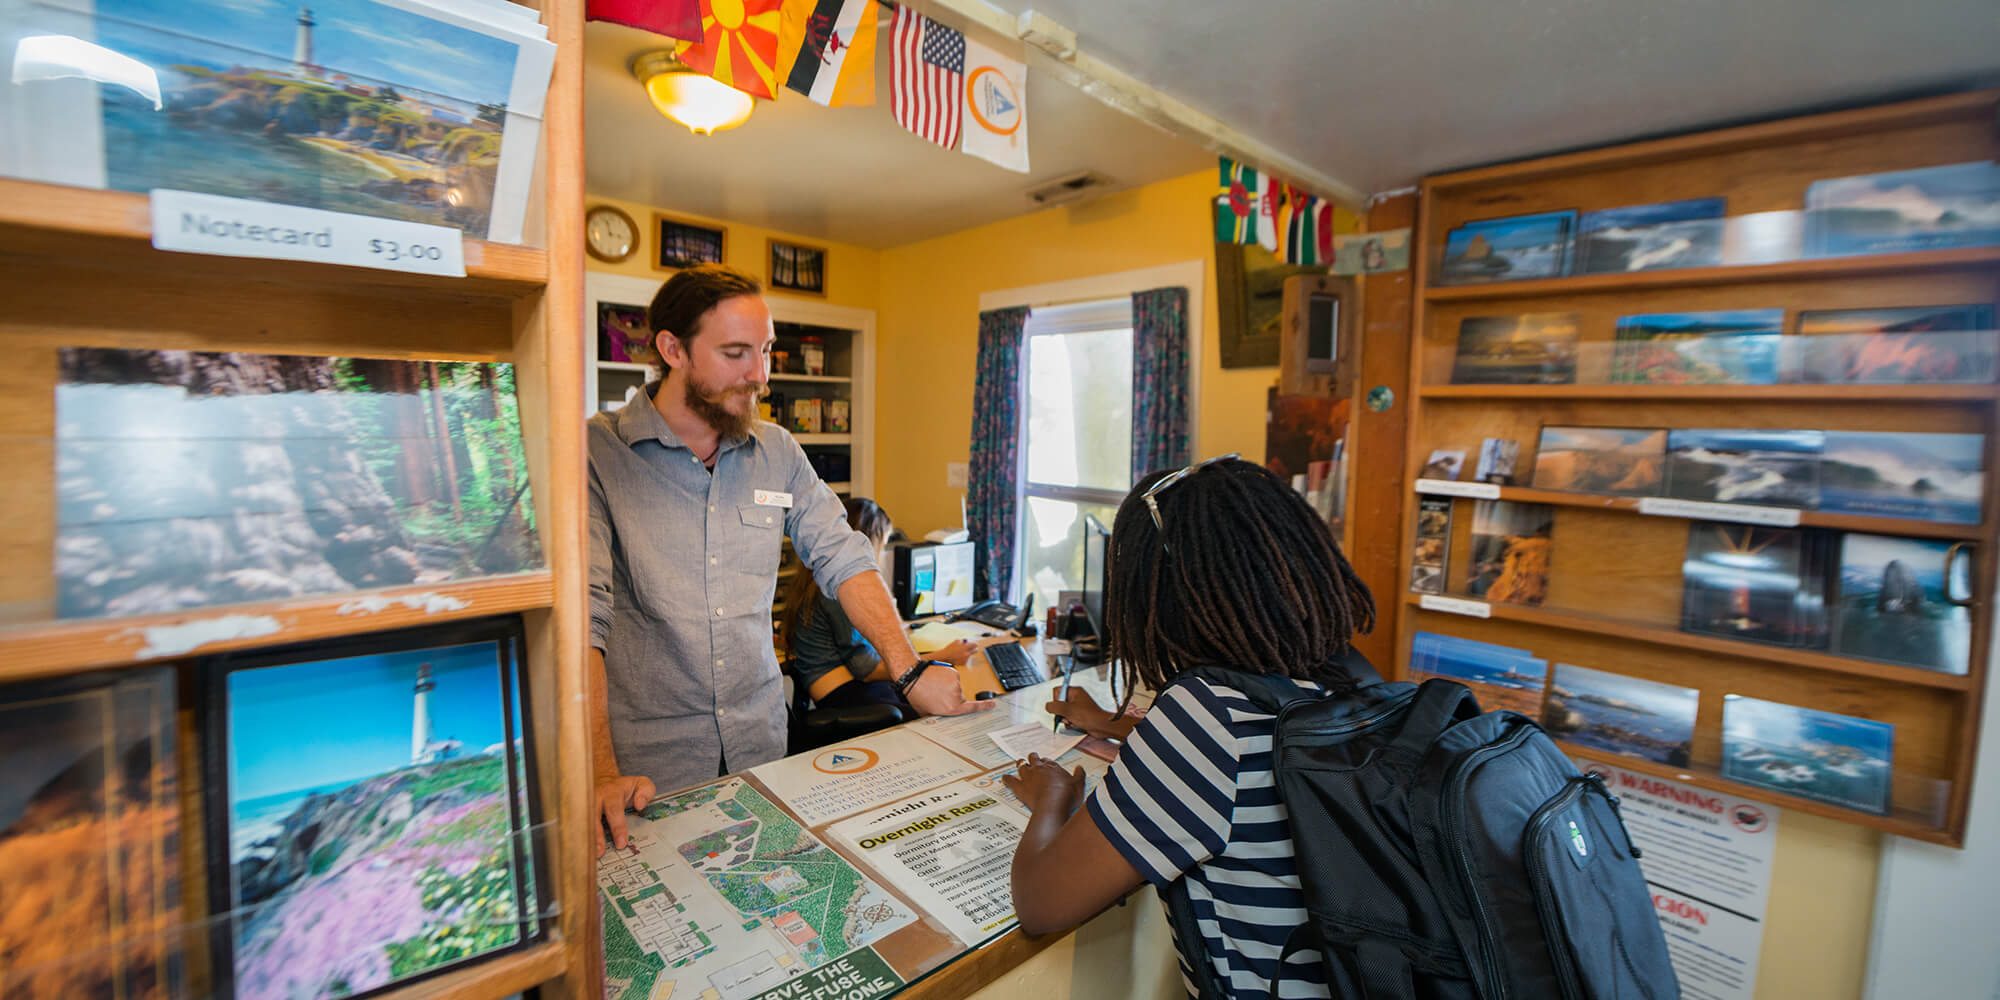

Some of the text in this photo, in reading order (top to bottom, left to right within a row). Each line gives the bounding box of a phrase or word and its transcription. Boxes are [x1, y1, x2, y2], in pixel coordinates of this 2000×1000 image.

[180, 212, 443, 261] Notecard $3.00
[1620, 772, 1723, 815] WARNING
[859, 812, 952, 849] Overnight
[948, 798, 998, 817] Rates
[893, 839, 940, 858] Dormitory
[939, 830, 958, 842] Bed
[902, 852, 928, 865] ADULT
[909, 857, 938, 871] YOUTH
[929, 873, 959, 888] Private
[959, 864, 980, 877] room
[964, 901, 993, 916] Groups
[972, 904, 1010, 925] Exclusive
[812, 958, 855, 983] THE
